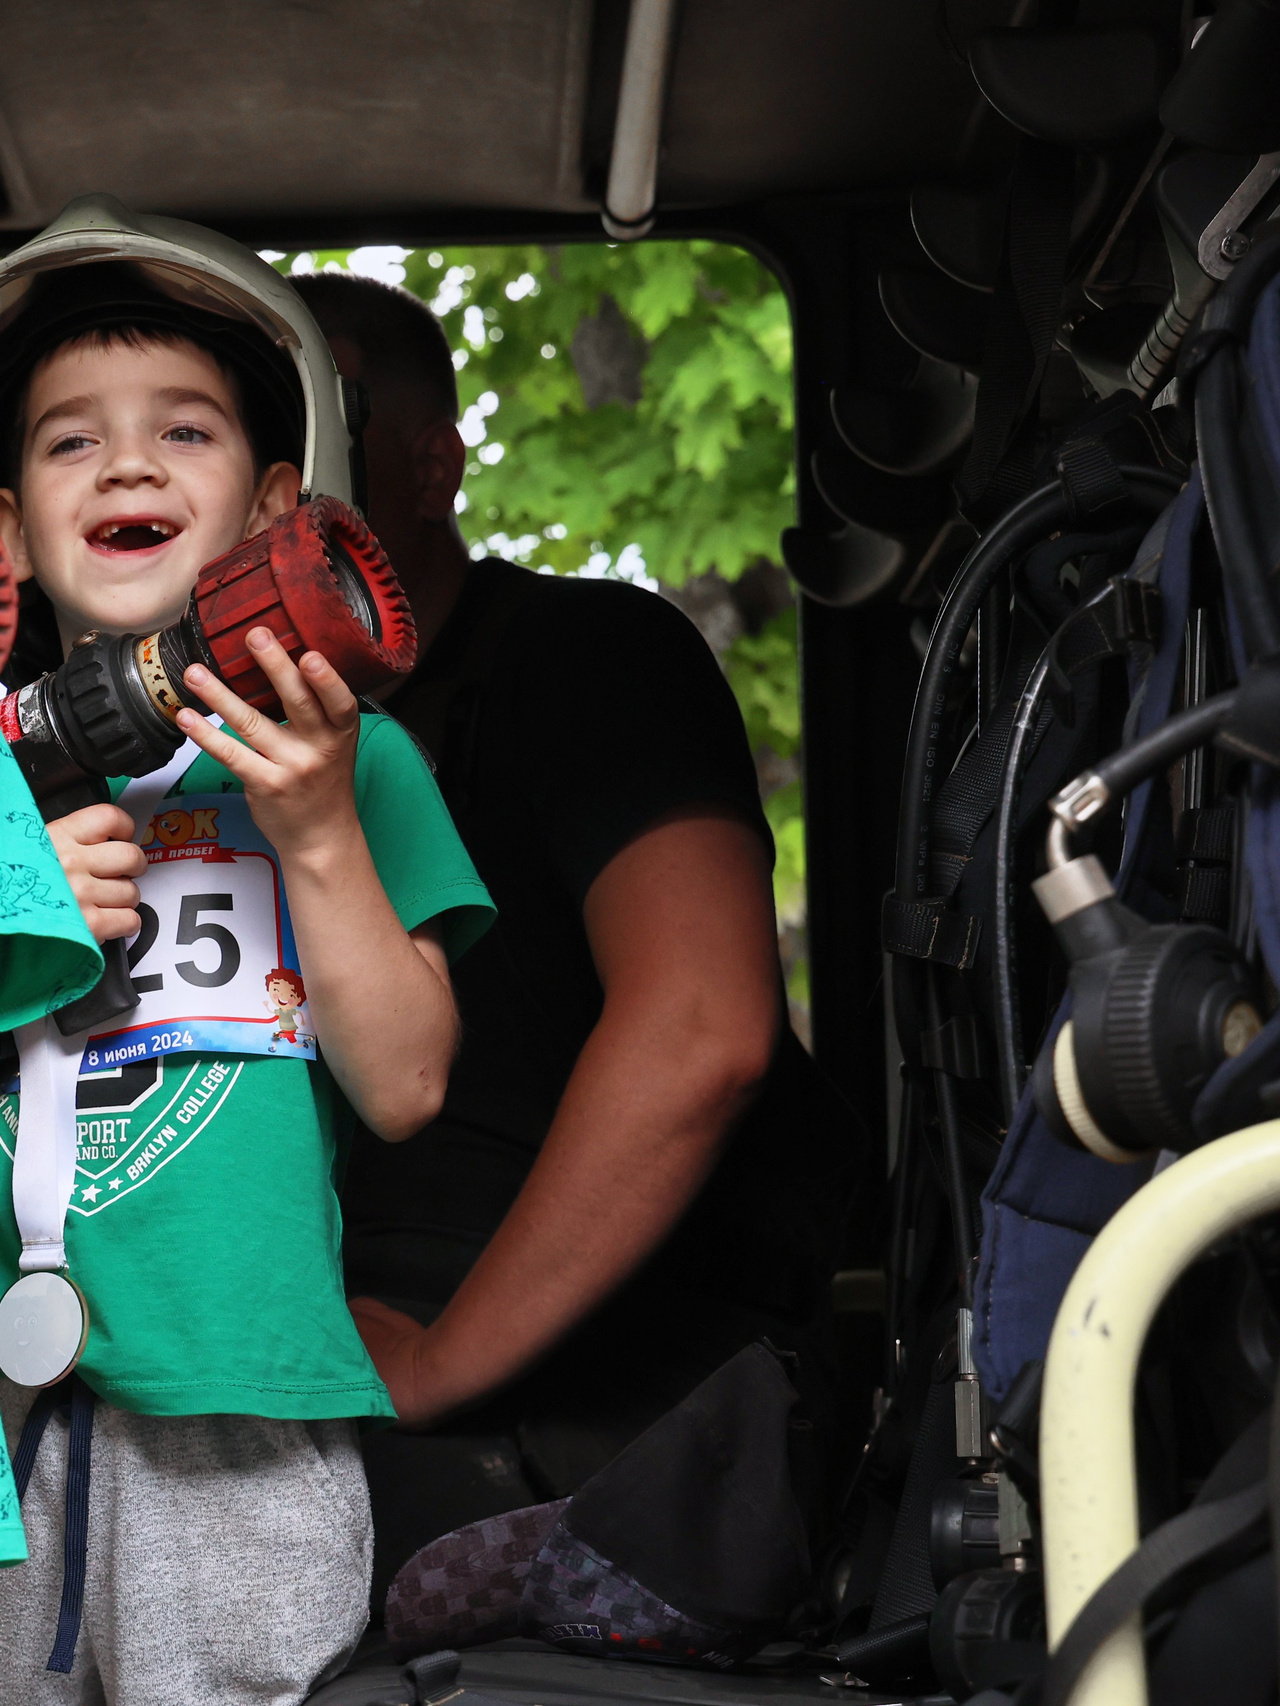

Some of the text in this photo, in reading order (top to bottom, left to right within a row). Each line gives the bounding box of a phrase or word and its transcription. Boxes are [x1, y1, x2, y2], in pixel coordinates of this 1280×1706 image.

[929, 722, 941, 740] EN
[925, 746, 937, 767] ISO
[168, 845, 216, 859] ПРОБЕГ
[88, 1031, 194, 1066] 8 июня 2024
[126, 1060, 231, 1182] BRKLYN COLLEGE
[76, 1118, 132, 1146] PORT
[101, 1145, 119, 1159] CO.
